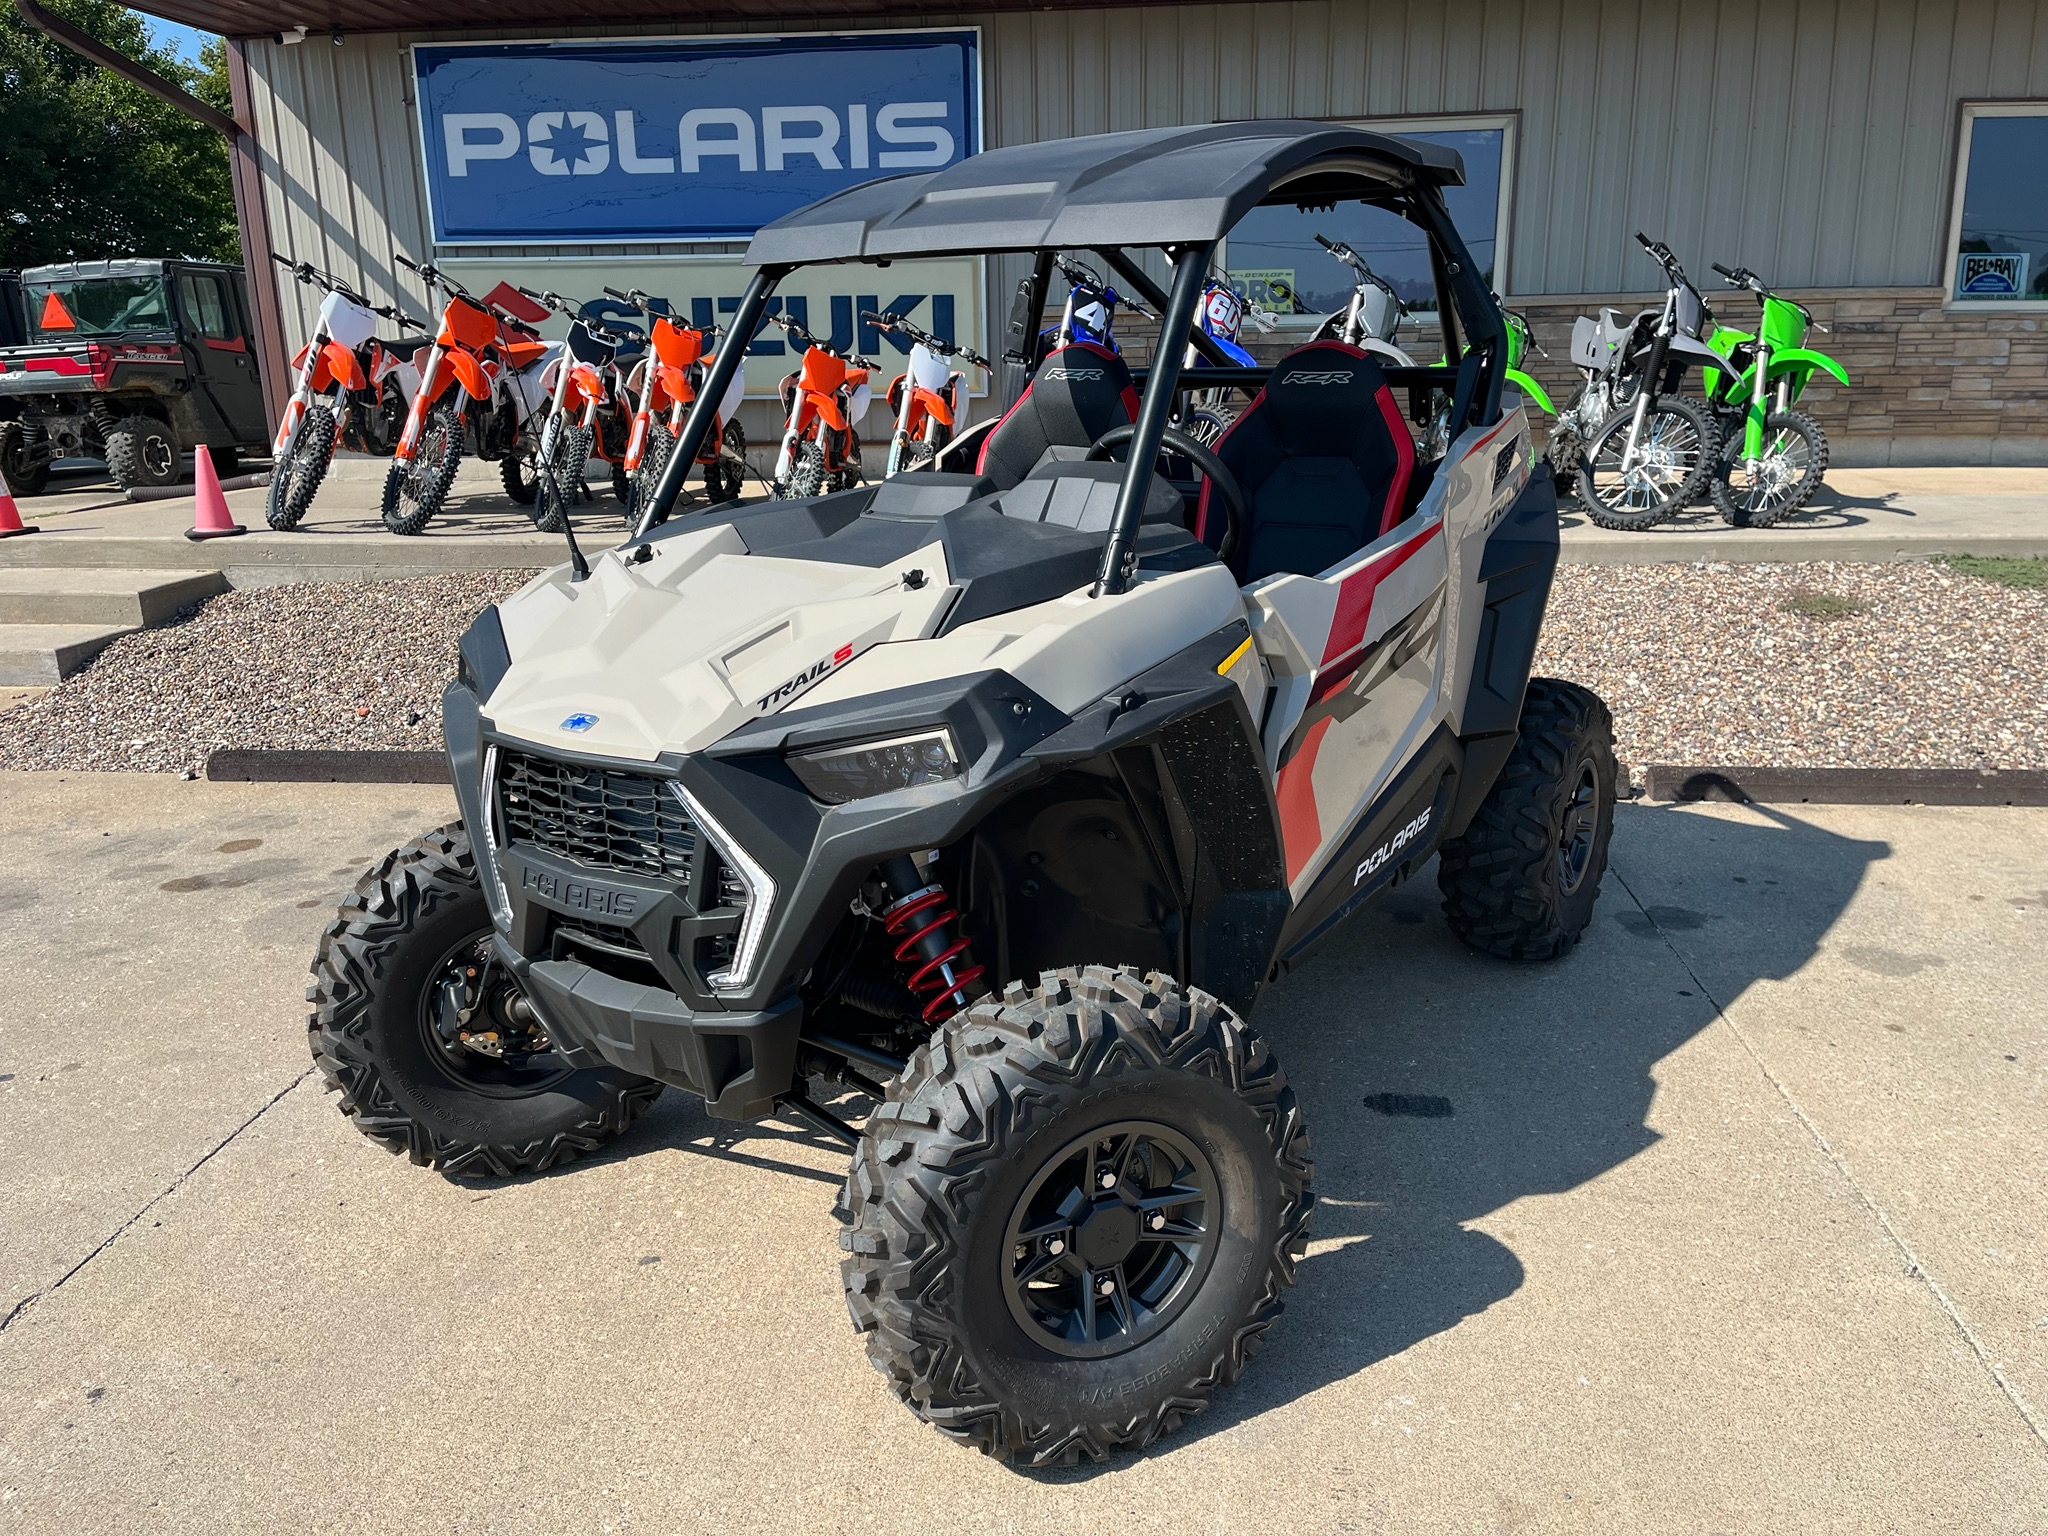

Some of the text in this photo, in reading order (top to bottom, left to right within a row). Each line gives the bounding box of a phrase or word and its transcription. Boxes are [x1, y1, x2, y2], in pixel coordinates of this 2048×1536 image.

[442, 101, 955, 177] POLARIS
[1228, 278, 1292, 304] PRO
[578, 294, 955, 357] SUZUKI
[1044, 367, 1105, 381] RZR
[1281, 370, 1354, 385] RZR
[757, 642, 853, 711] TRAIL S
[1353, 806, 1432, 887] POLARIS
[522, 867, 638, 919] POLARIS
